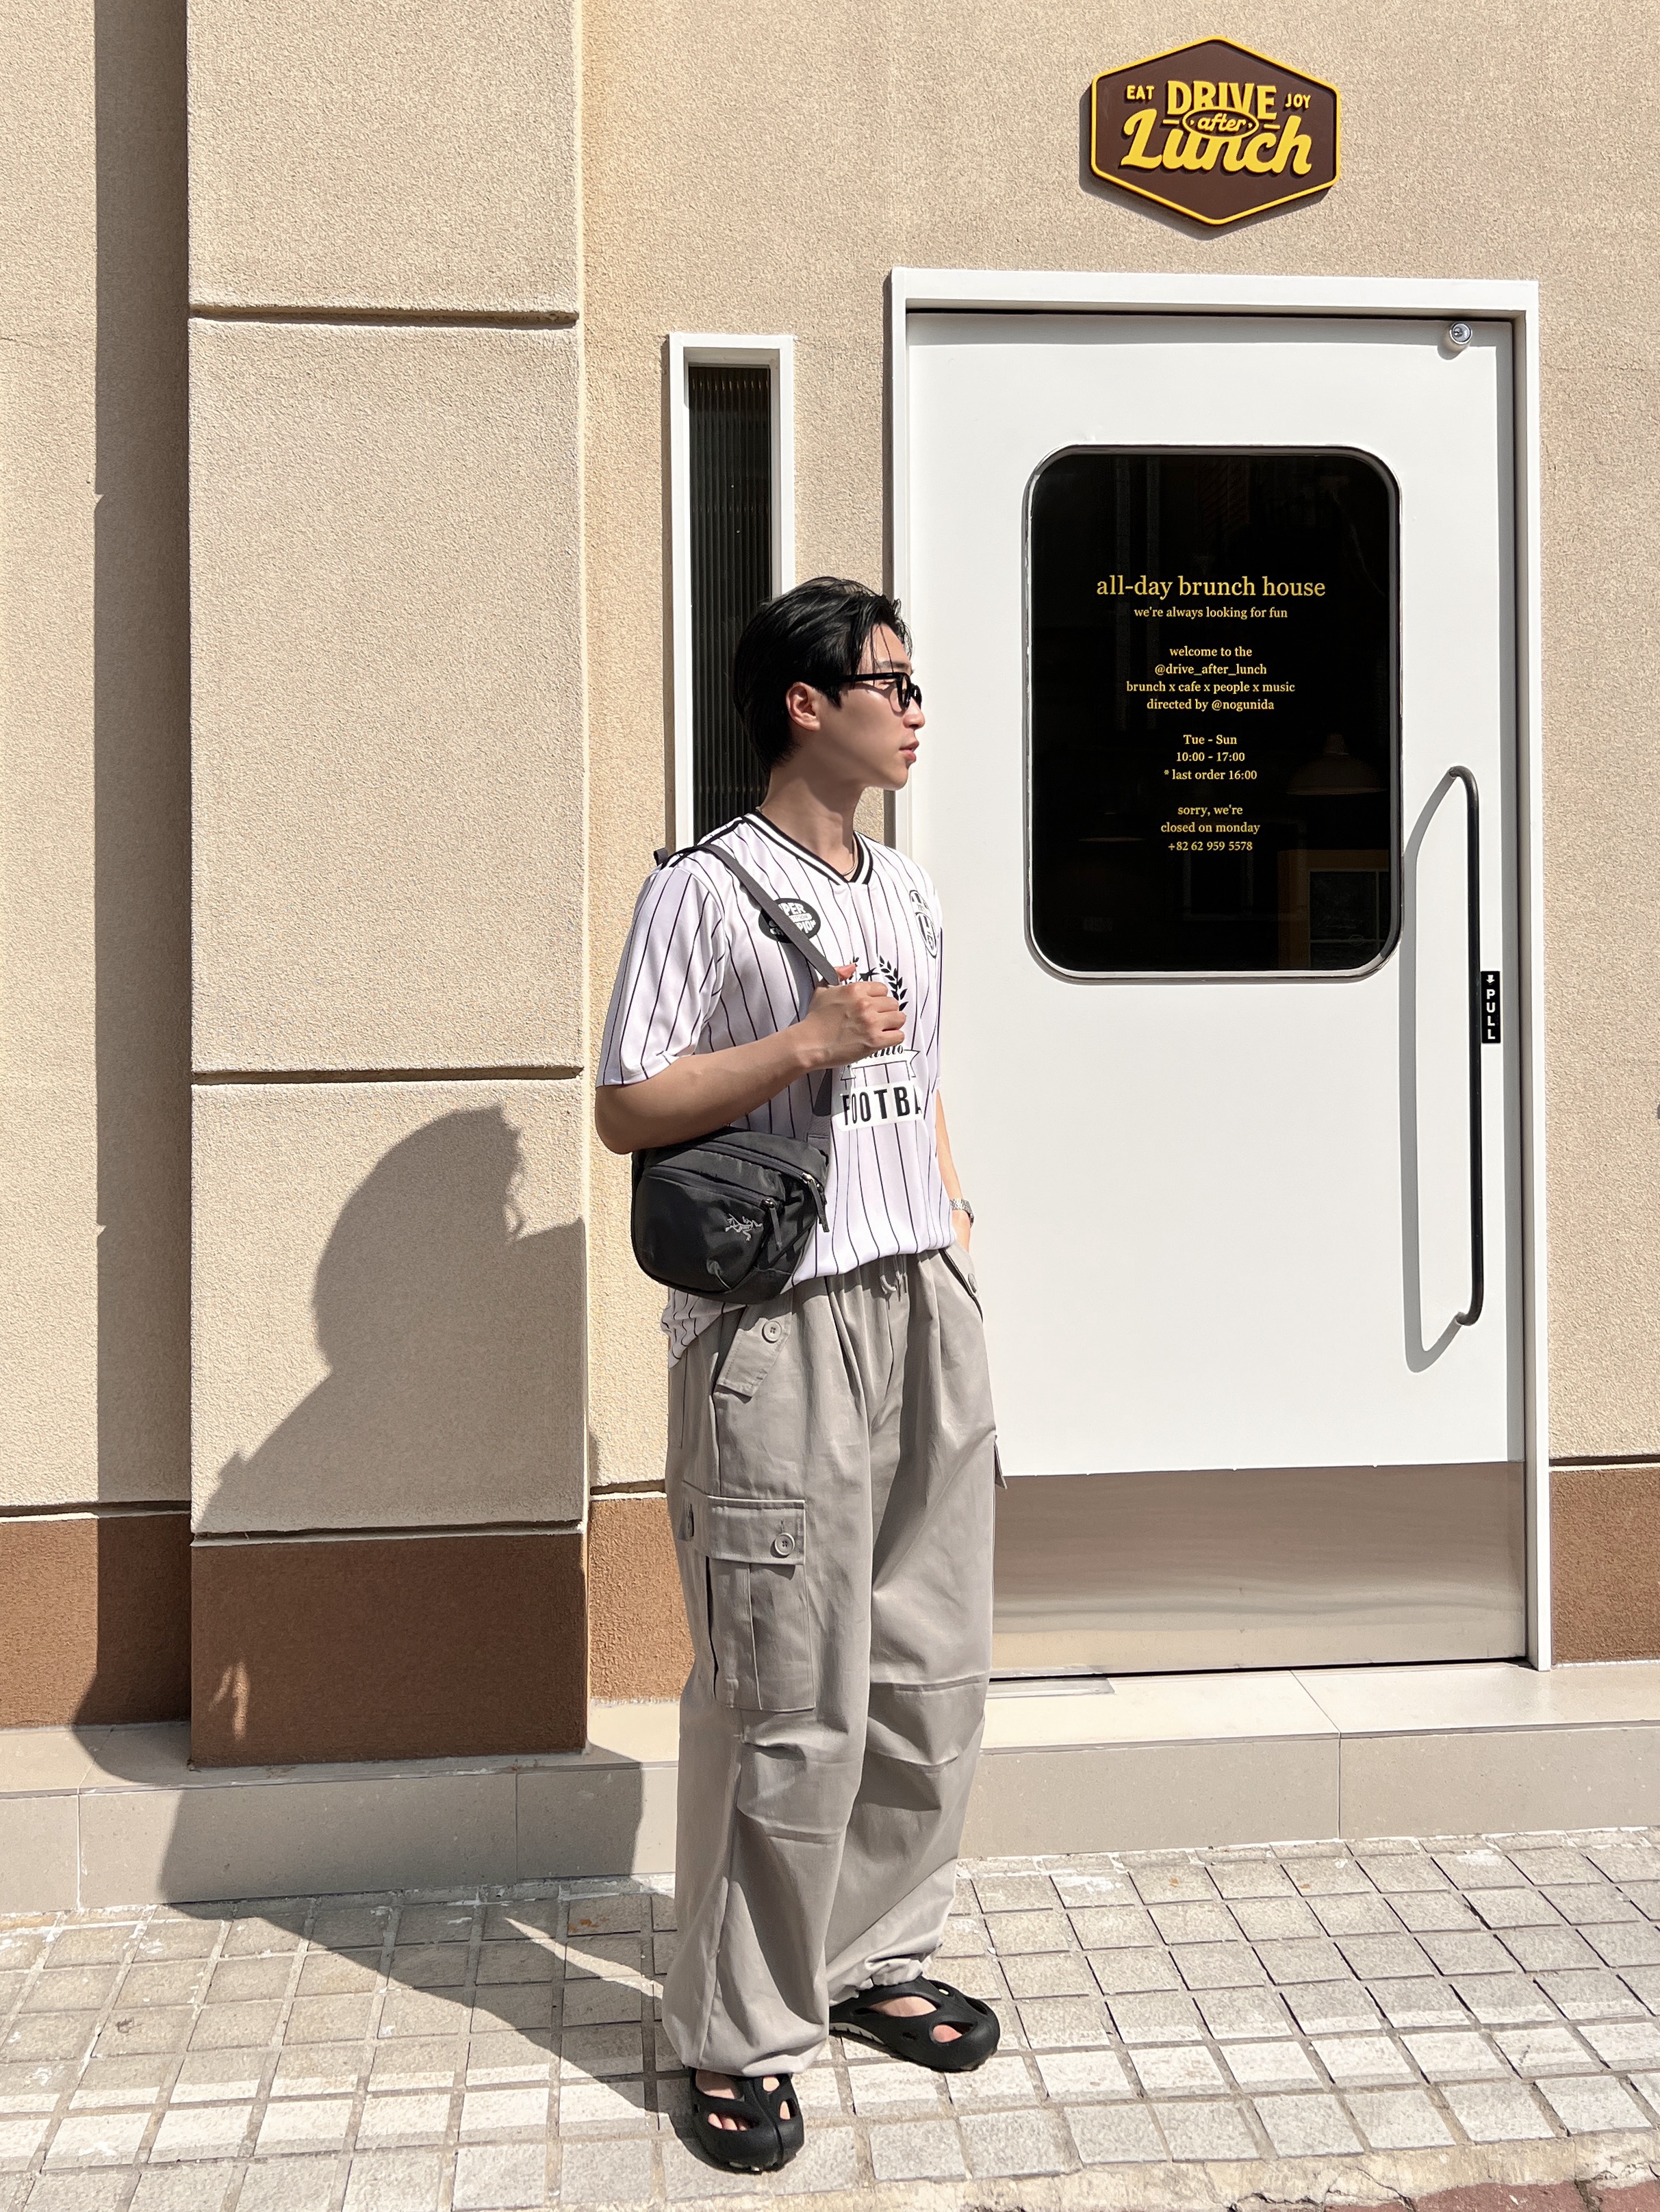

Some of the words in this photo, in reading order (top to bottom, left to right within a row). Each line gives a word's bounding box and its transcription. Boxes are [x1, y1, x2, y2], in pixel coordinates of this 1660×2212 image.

[1126, 85, 1155, 101] EAT
[1166, 80, 1277, 120] DRIVE
[1286, 93, 1312, 109] JOY
[1197, 113, 1250, 132] after
[1121, 108, 1312, 175] Lunch
[1097, 574, 1173, 601] all-day
[1177, 575, 1256, 596] brunch
[1262, 576, 1326, 597] house
[1134, 606, 1164, 617] we're
[1166, 606, 1203, 620] always
[1205, 606, 1248, 620] looking
[1250, 606, 1267, 618] for
[1268, 606, 1288, 618] fun
[1169, 645, 1218, 657] welcome
[1220, 647, 1231, 657] to
[1234, 645, 1253, 657] the
[1154, 663, 1267, 676] @drive_after_lunch
[1126, 680, 1166, 692] brunch
[1169, 684, 1176, 692] x
[1178, 680, 1201, 692] cafe
[1203, 684, 1211, 692] x
[1213, 681, 1250, 694] people
[1252, 684, 1260, 693] x
[1262, 681, 1295, 692] music
[1147, 698, 1192, 710] directed
[1195, 698, 1209, 712] by
[1211, 698, 1275, 712] @nogunida
[1183, 734, 1205, 745] Tue
[1216, 734, 1238, 745] Sun
[1176, 751, 1205, 762] 10:00
[1216, 751, 1245, 762] 17:00
[1172, 769, 1192, 780] last
[1195, 769, 1226, 780] order
[1229, 770, 1257, 780] 16:00
[1177, 807, 1211, 818] sorry,
[1213, 803, 1243, 815] we're
[1160, 821, 1196, 833] closed
[1198, 824, 1212, 833] on
[1215, 821, 1261, 835] monday
[1168, 841, 1189, 851] +82
[1190, 841, 1203, 851] 62
[1206, 841, 1225, 851] 959
[1228, 841, 1253, 851] 5578
[1486, 988, 1496, 1040] PULL
